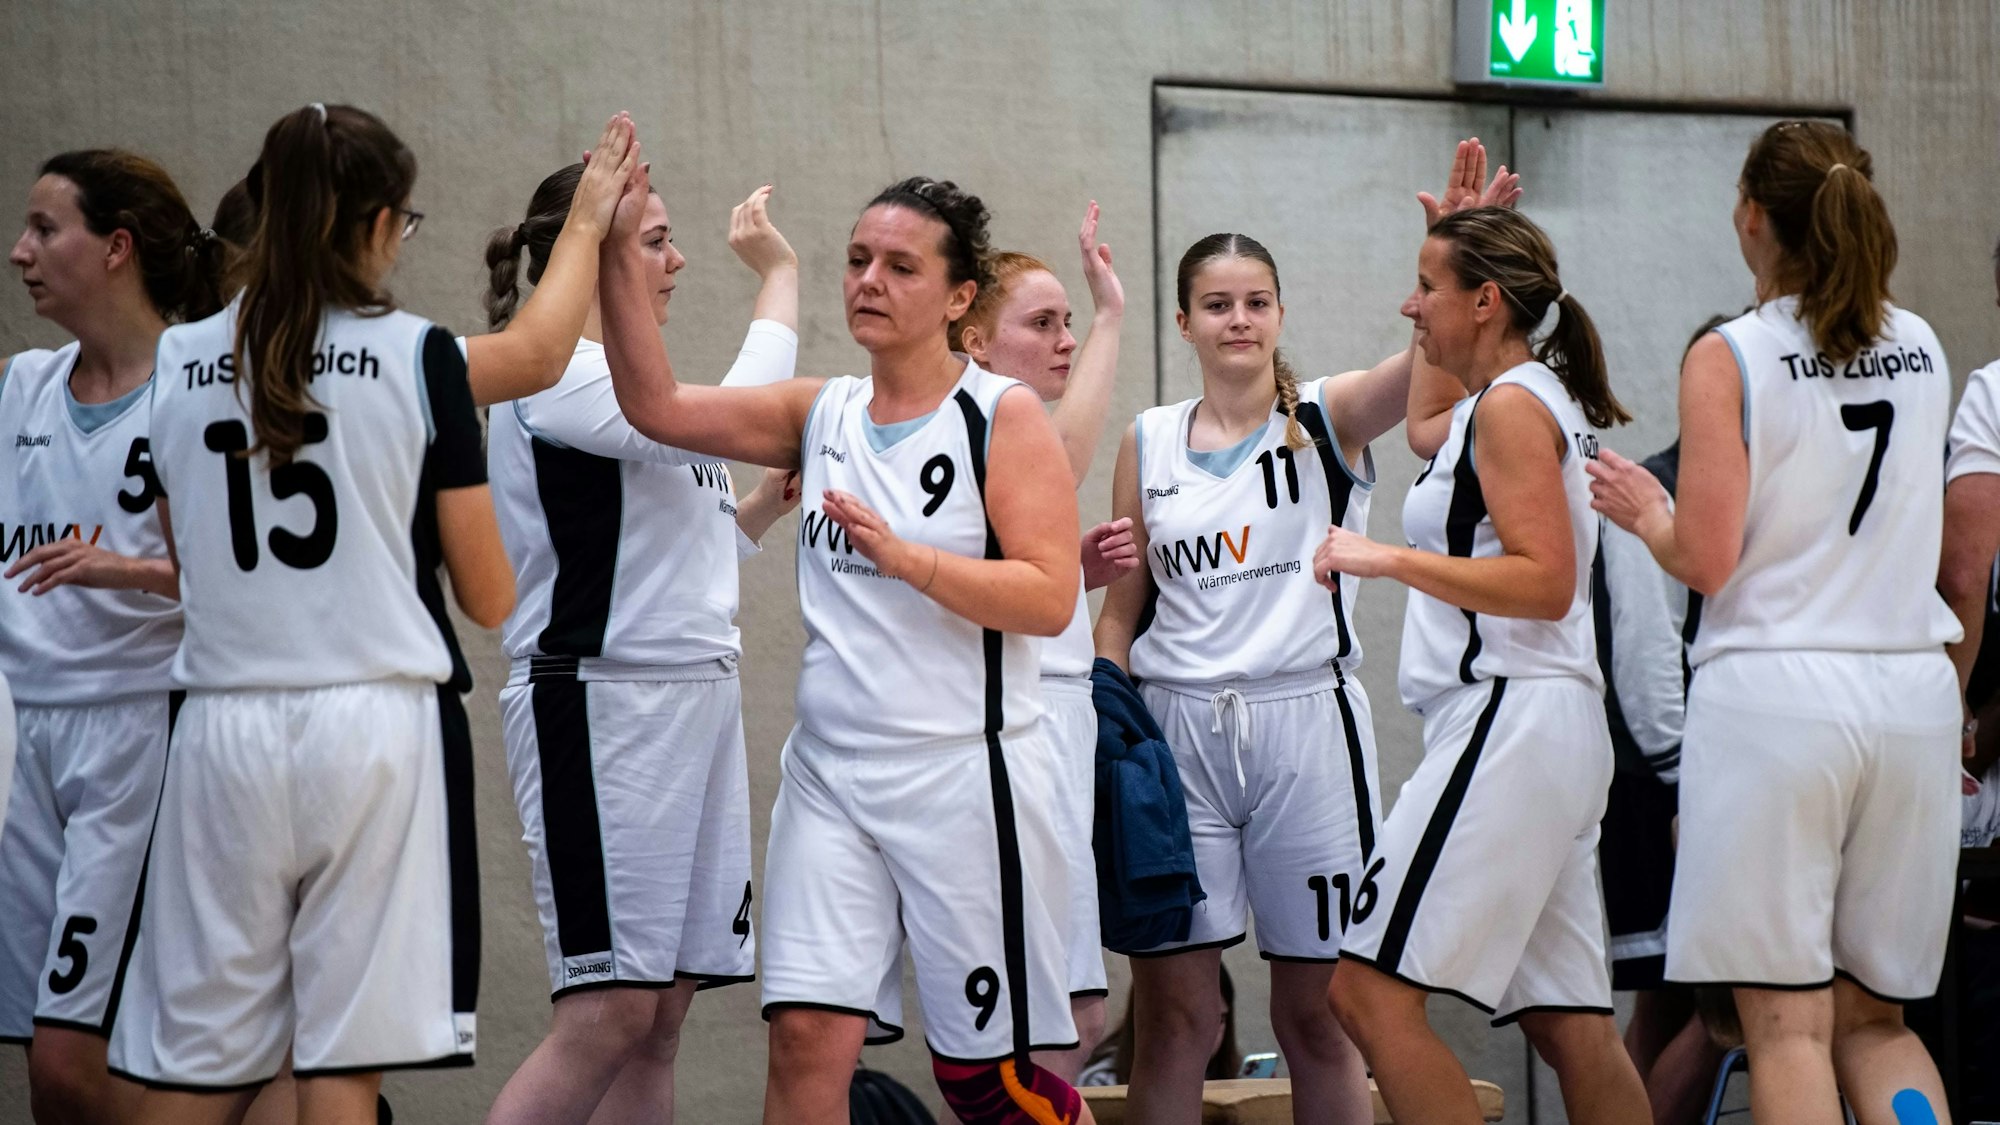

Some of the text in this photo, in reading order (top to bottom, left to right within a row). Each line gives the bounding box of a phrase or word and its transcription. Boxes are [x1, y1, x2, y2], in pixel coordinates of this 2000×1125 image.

[183, 344, 379, 390] TuS pich
[1780, 352, 1835, 380] TuS
[117, 436, 156, 514] 5
[204, 412, 338, 571] 15
[920, 453, 955, 517] 9
[1255, 446, 1300, 509] 11
[1840, 400, 1894, 536] 7
[1154, 525, 1251, 579] WWV
[1198, 560, 1301, 590] Wärmeverwertung
[1307, 872, 1351, 942] 11
[1351, 856, 1386, 925] 6
[48, 915, 97, 994] 5
[568, 961, 611, 979] SPALDING
[965, 965, 1000, 1032] 9
